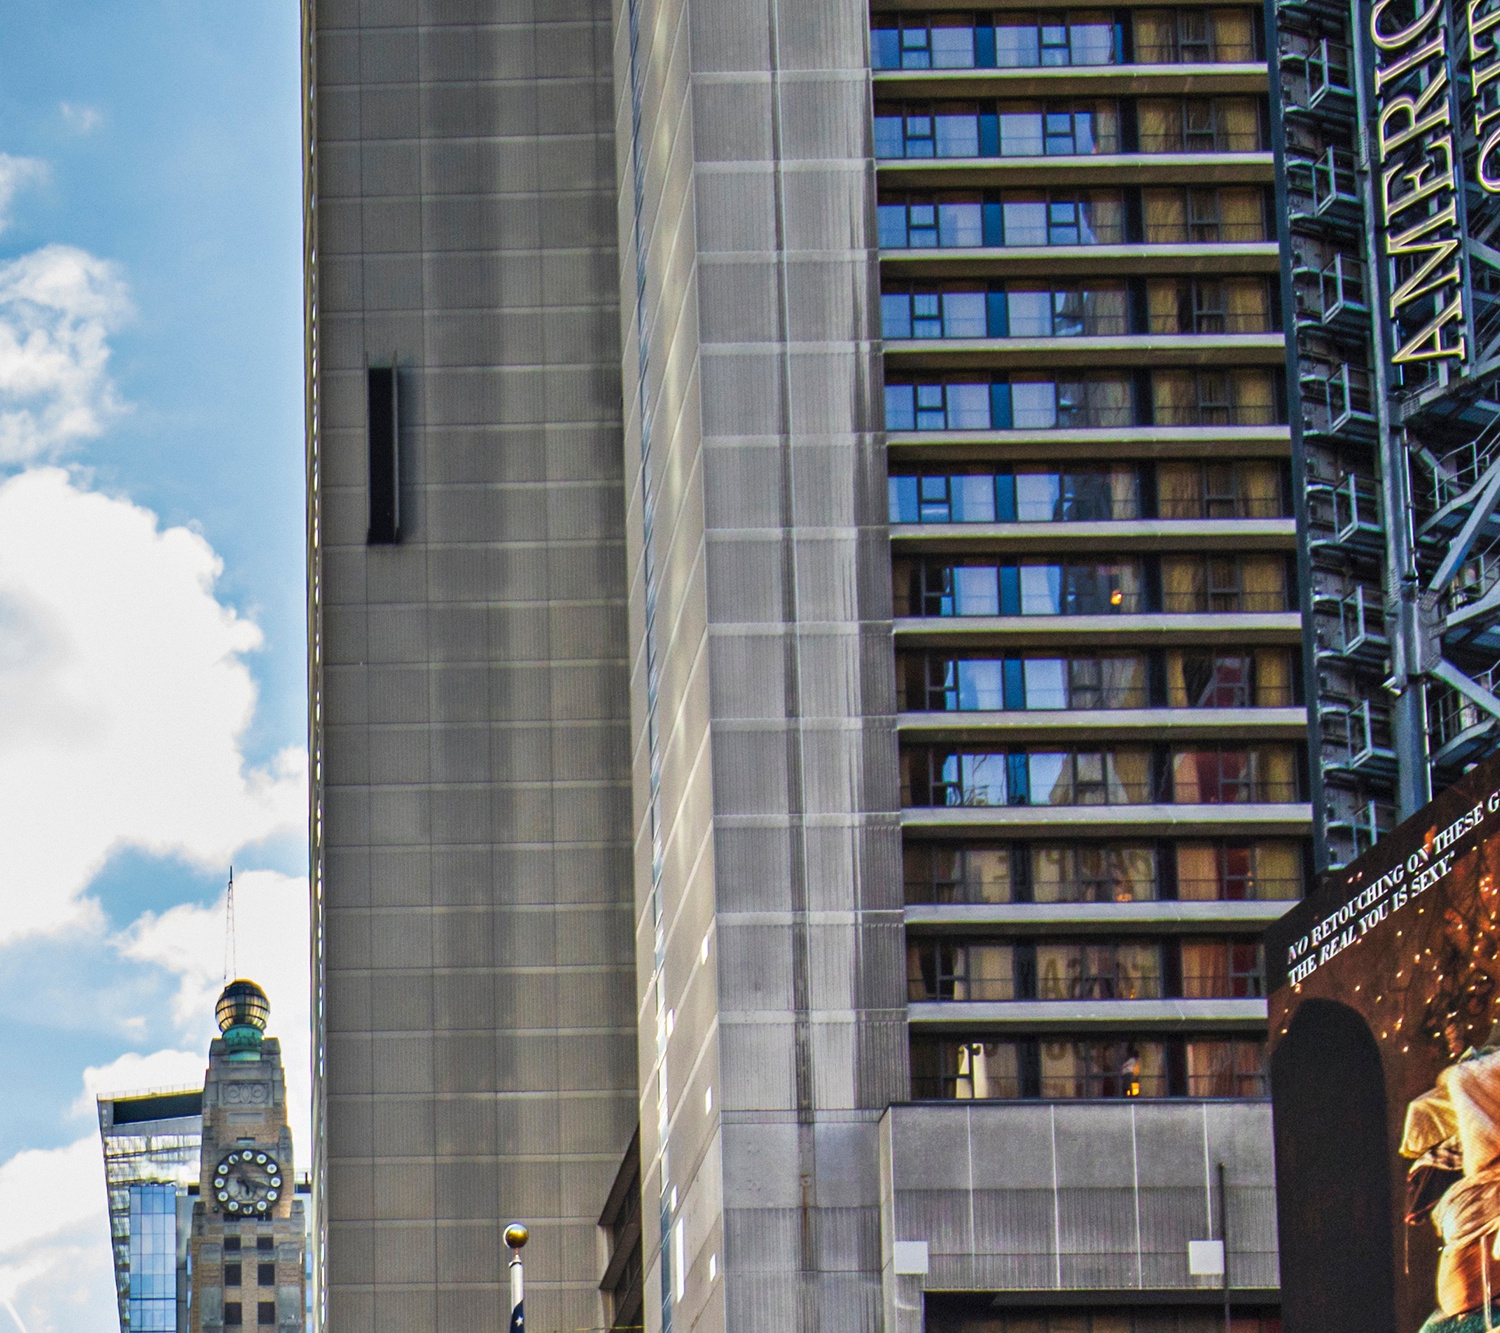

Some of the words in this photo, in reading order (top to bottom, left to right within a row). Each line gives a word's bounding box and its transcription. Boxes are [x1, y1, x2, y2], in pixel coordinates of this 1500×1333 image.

[1286, 931, 1308, 964] NO
[1311, 869, 1404, 946] RETOUCHING
[1433, 803, 1485, 859] THESE
